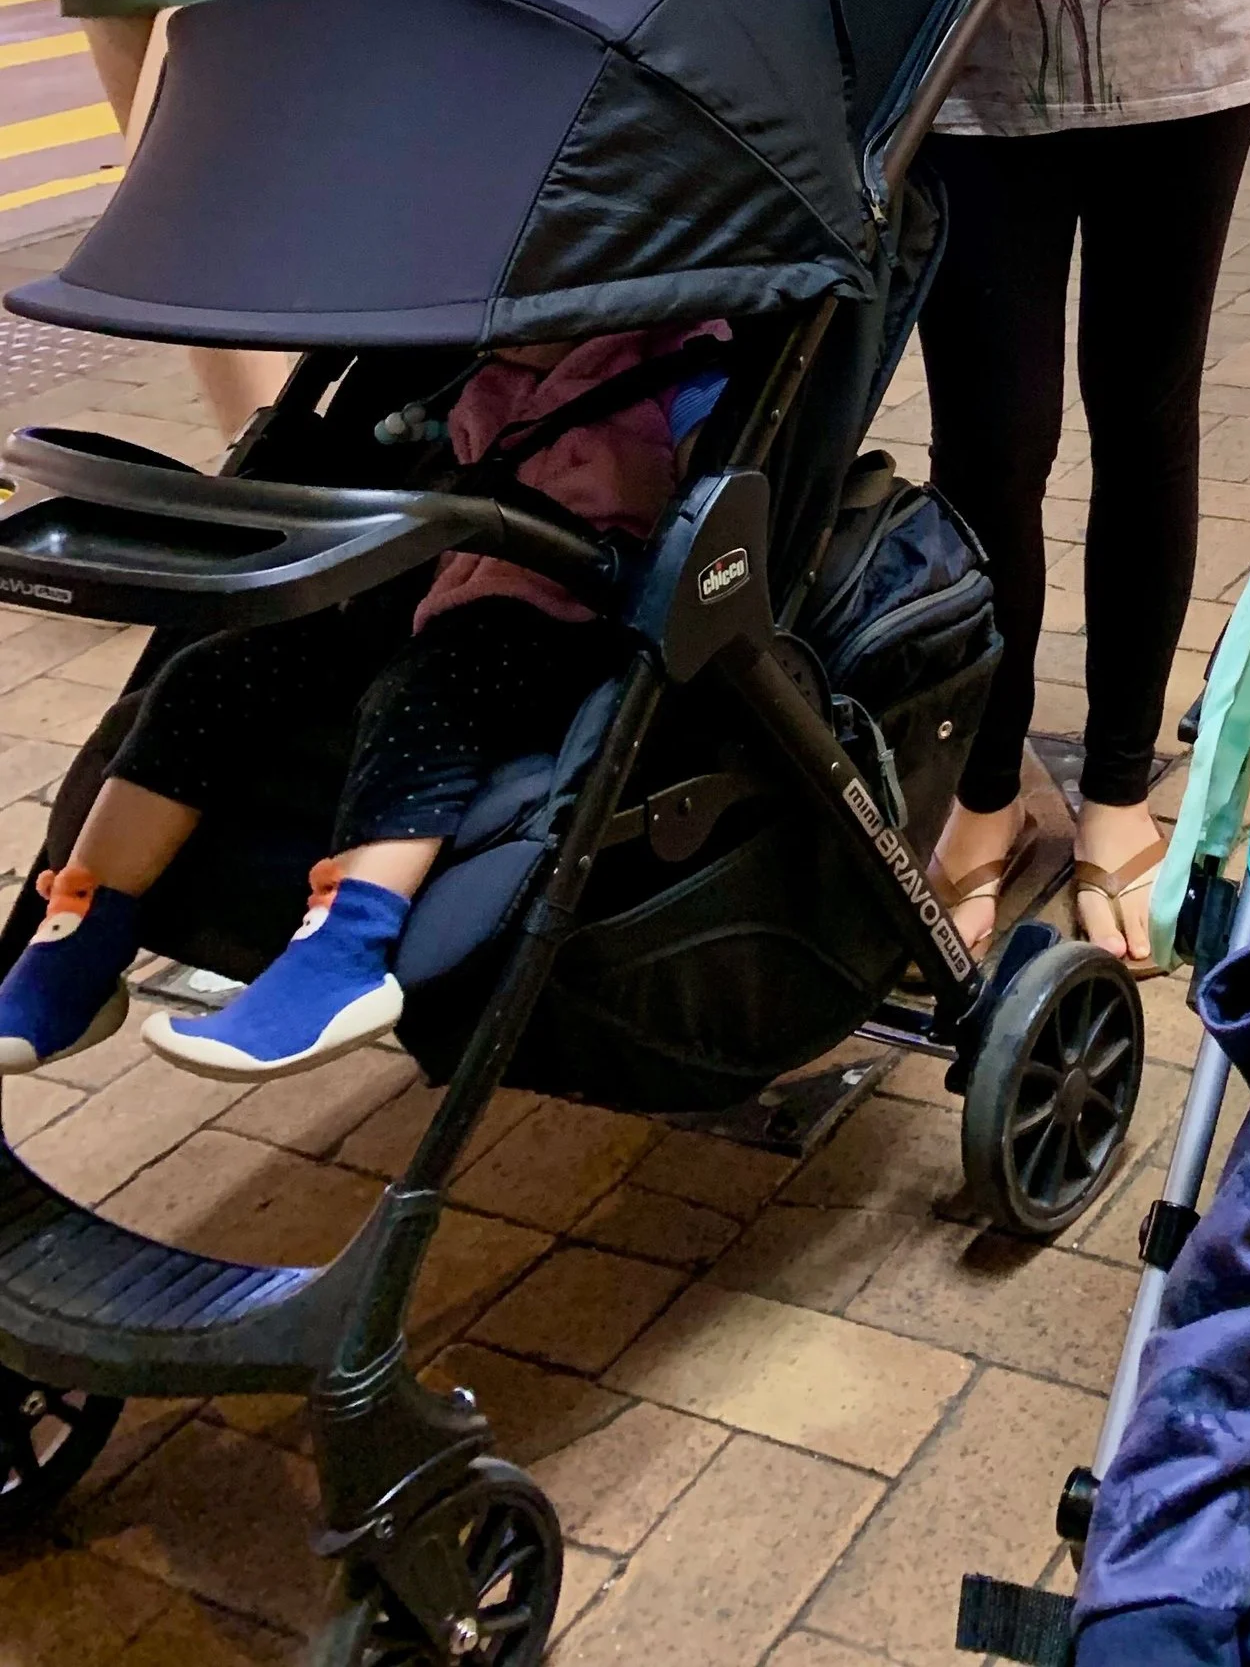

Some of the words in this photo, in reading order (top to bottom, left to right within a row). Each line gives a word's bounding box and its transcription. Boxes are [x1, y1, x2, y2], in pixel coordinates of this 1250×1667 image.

[703, 560, 745, 595] chicco
[848, 783, 881, 835] mini
[875, 825, 941, 927] BRAVO
[934, 924, 968, 977] PLUS
